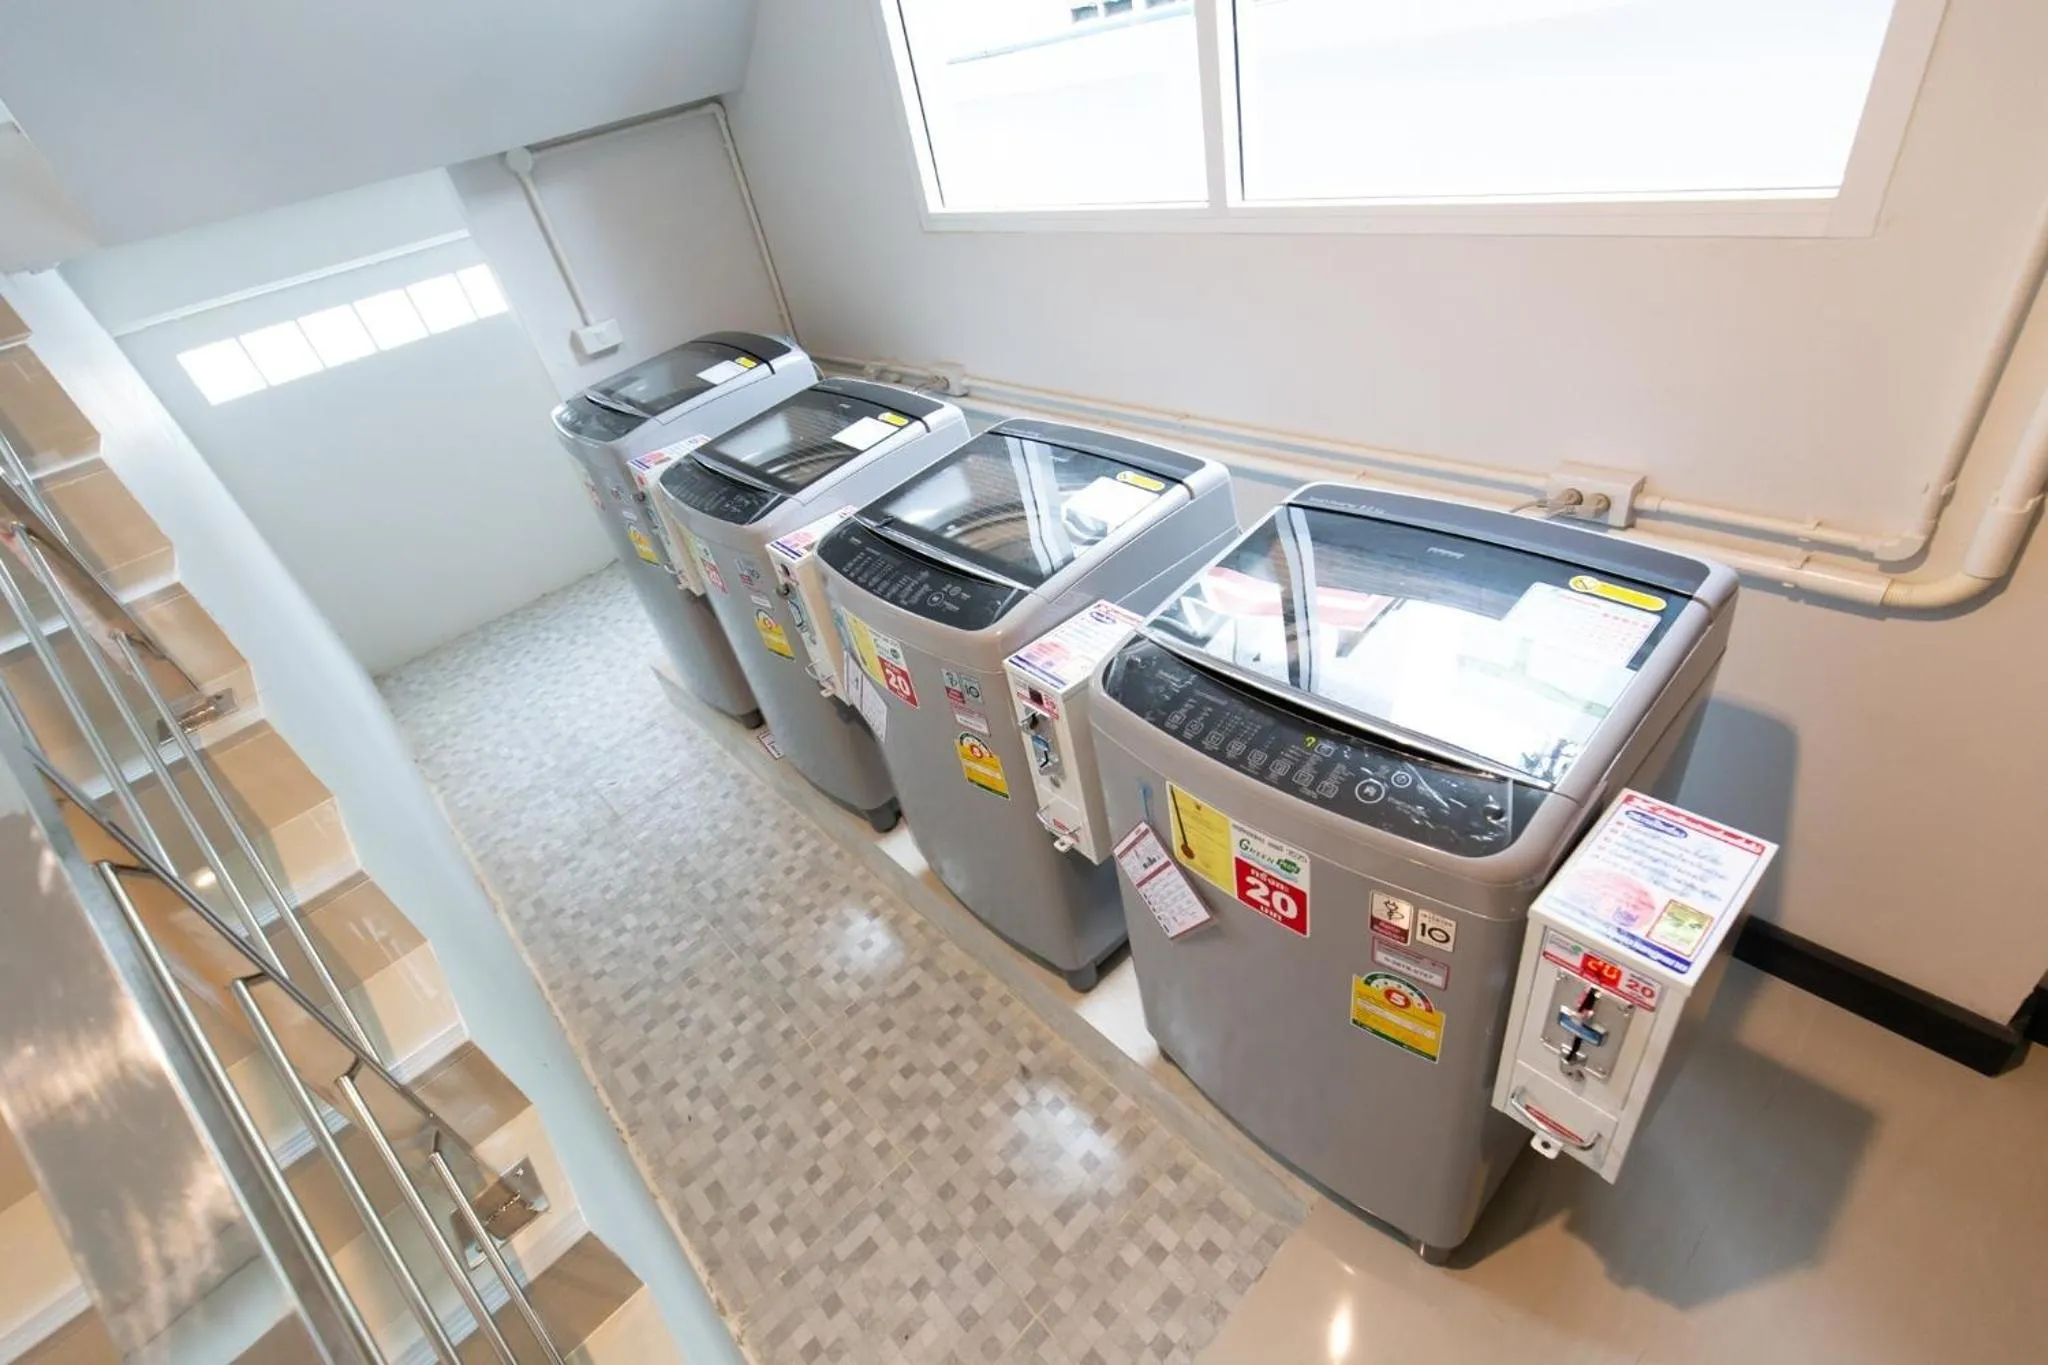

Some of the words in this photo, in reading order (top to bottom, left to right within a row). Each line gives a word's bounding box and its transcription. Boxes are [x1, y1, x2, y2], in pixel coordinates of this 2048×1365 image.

[1245, 876, 1298, 920] 20
[1420, 922, 1451, 944] 10
[1625, 978, 1655, 999] 20
